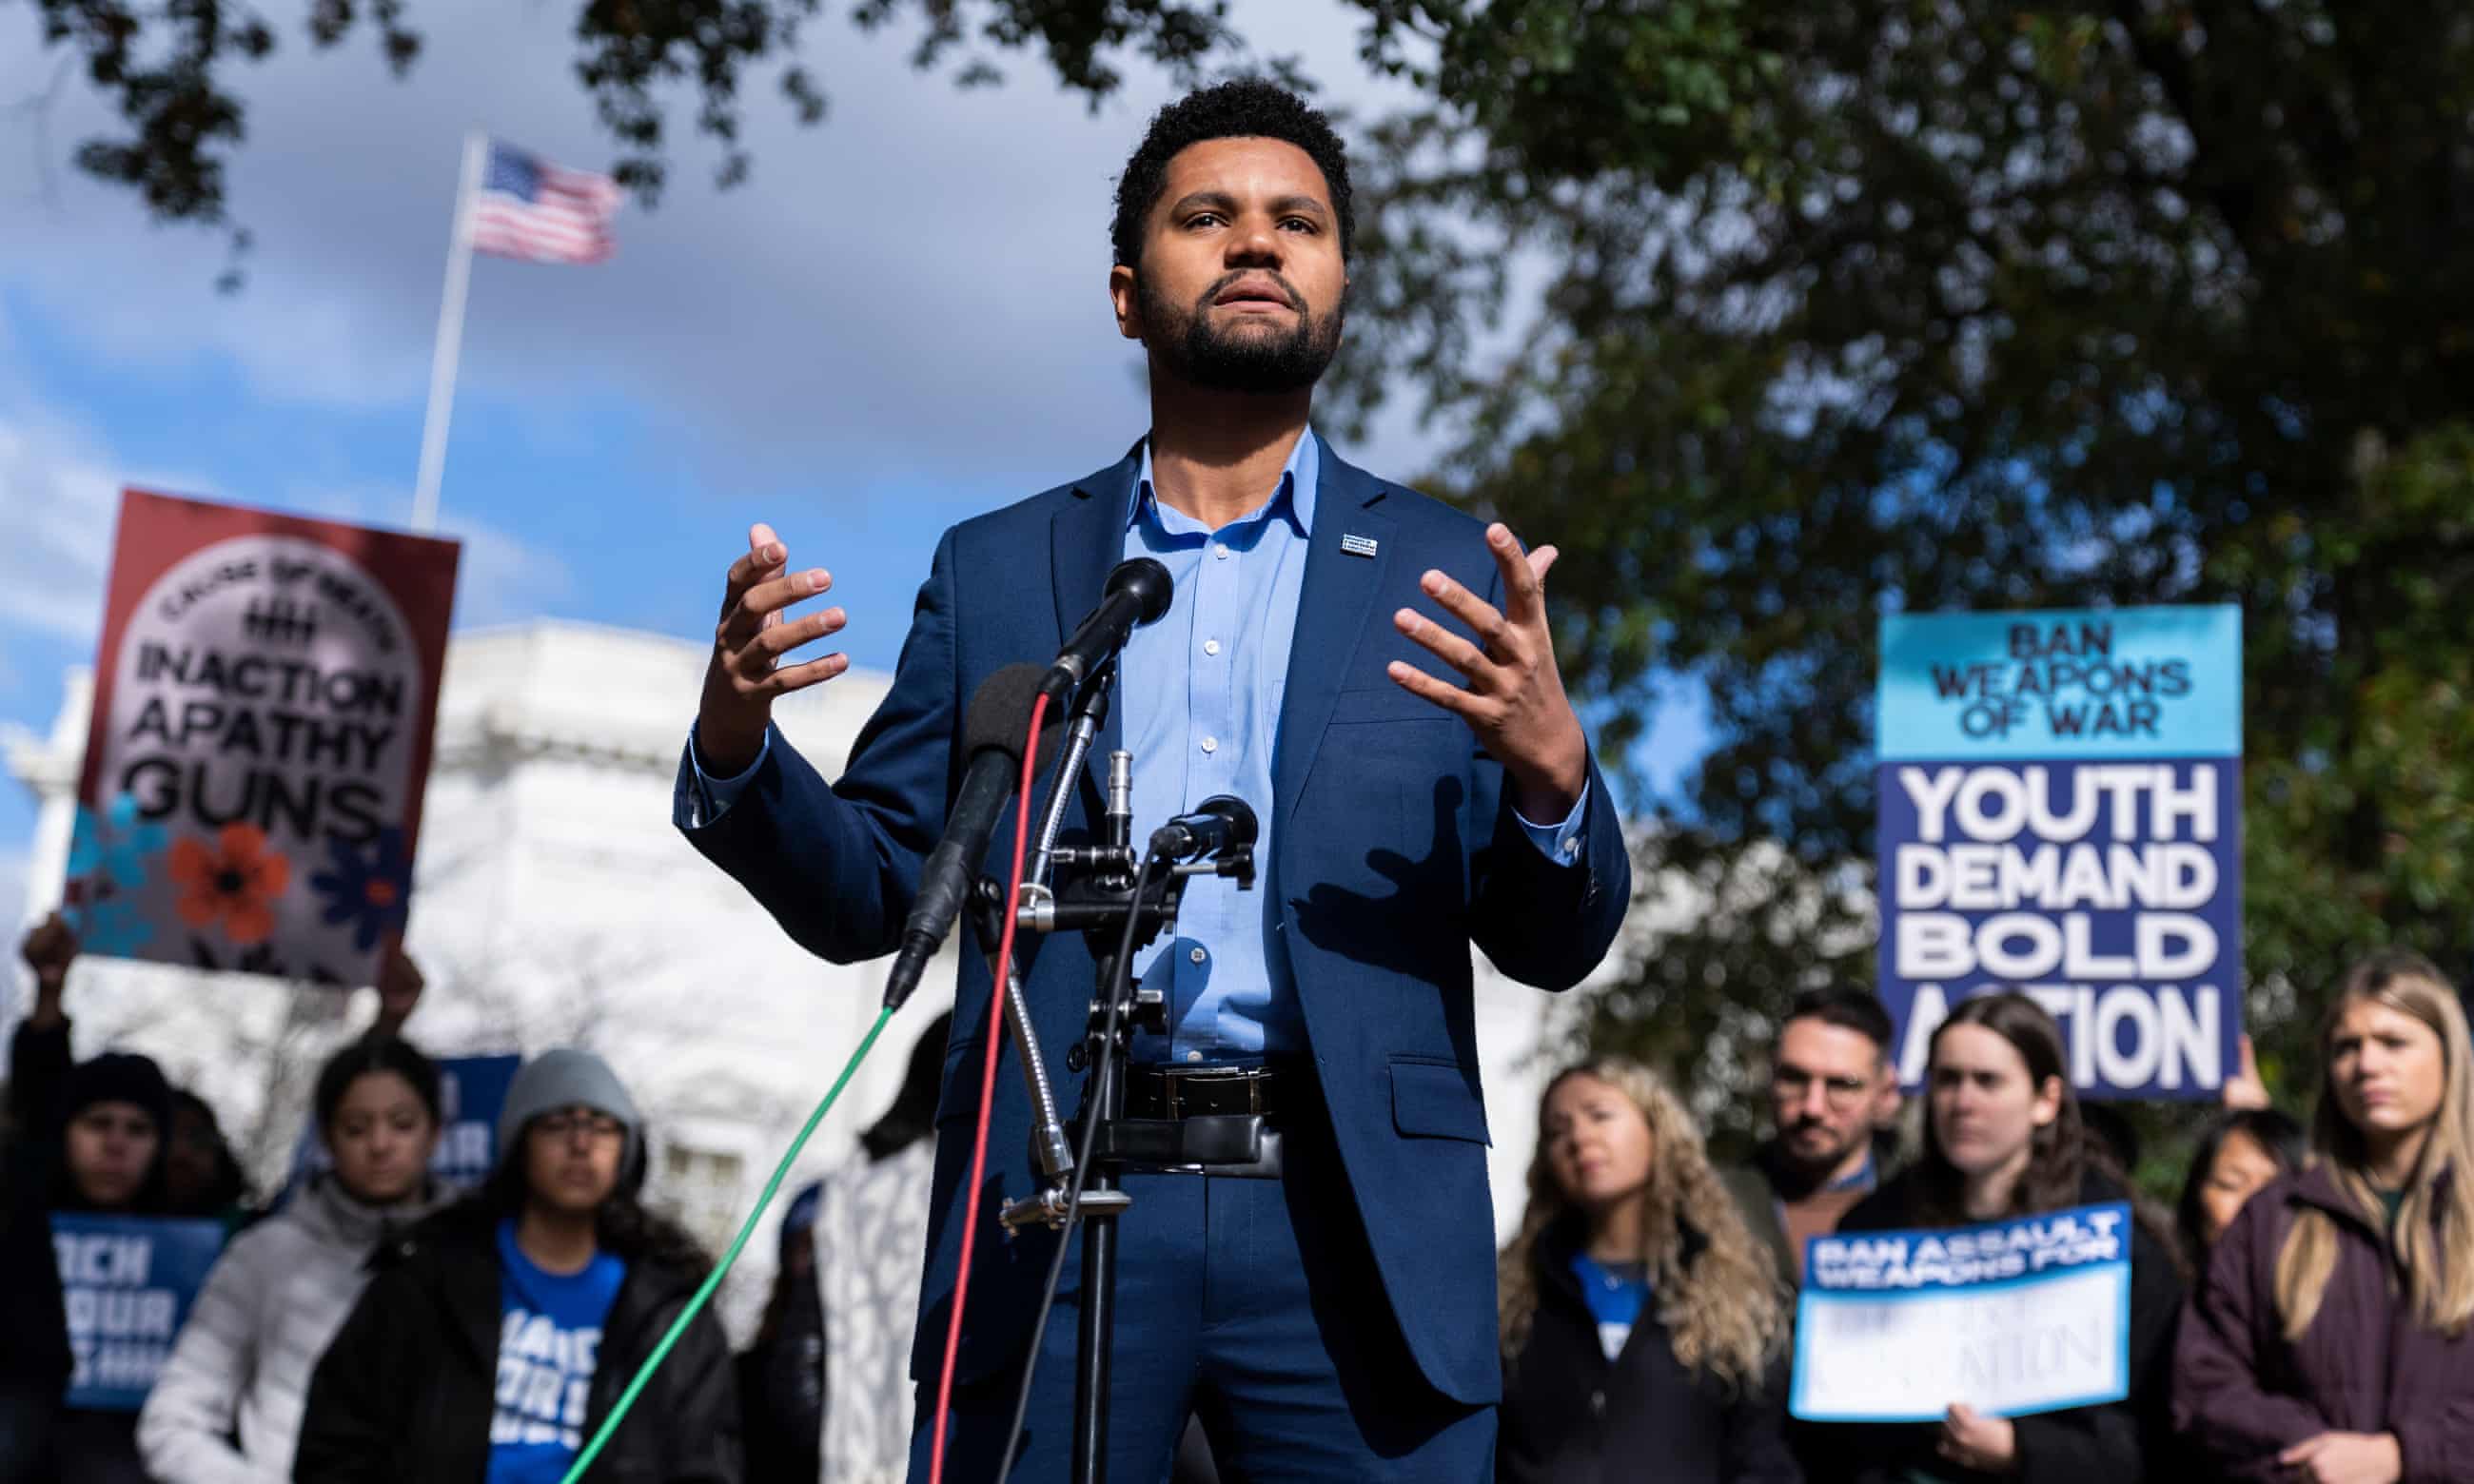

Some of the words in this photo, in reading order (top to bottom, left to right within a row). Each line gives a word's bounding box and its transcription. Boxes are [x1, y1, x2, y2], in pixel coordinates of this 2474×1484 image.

[2009, 623, 2111, 658] BAN
[137, 643, 403, 718] INACTION
[1931, 661, 2192, 701] WEAPONS
[129, 698, 393, 771] APATHY
[1959, 699, 2030, 738] OF
[2045, 700, 2163, 738] WAR
[121, 757, 383, 845] GUNS
[1900, 766, 2217, 843] YOUTH
[1896, 842, 2218, 910] DEMAND
[1895, 912, 2218, 979] BOLD
[1814, 1239, 1907, 1265] BAN
[1912, 1211, 2122, 1263] ASSAULT
[1815, 1255, 2026, 1289] WEAPONS
[2029, 1239, 2120, 1271] FOR
